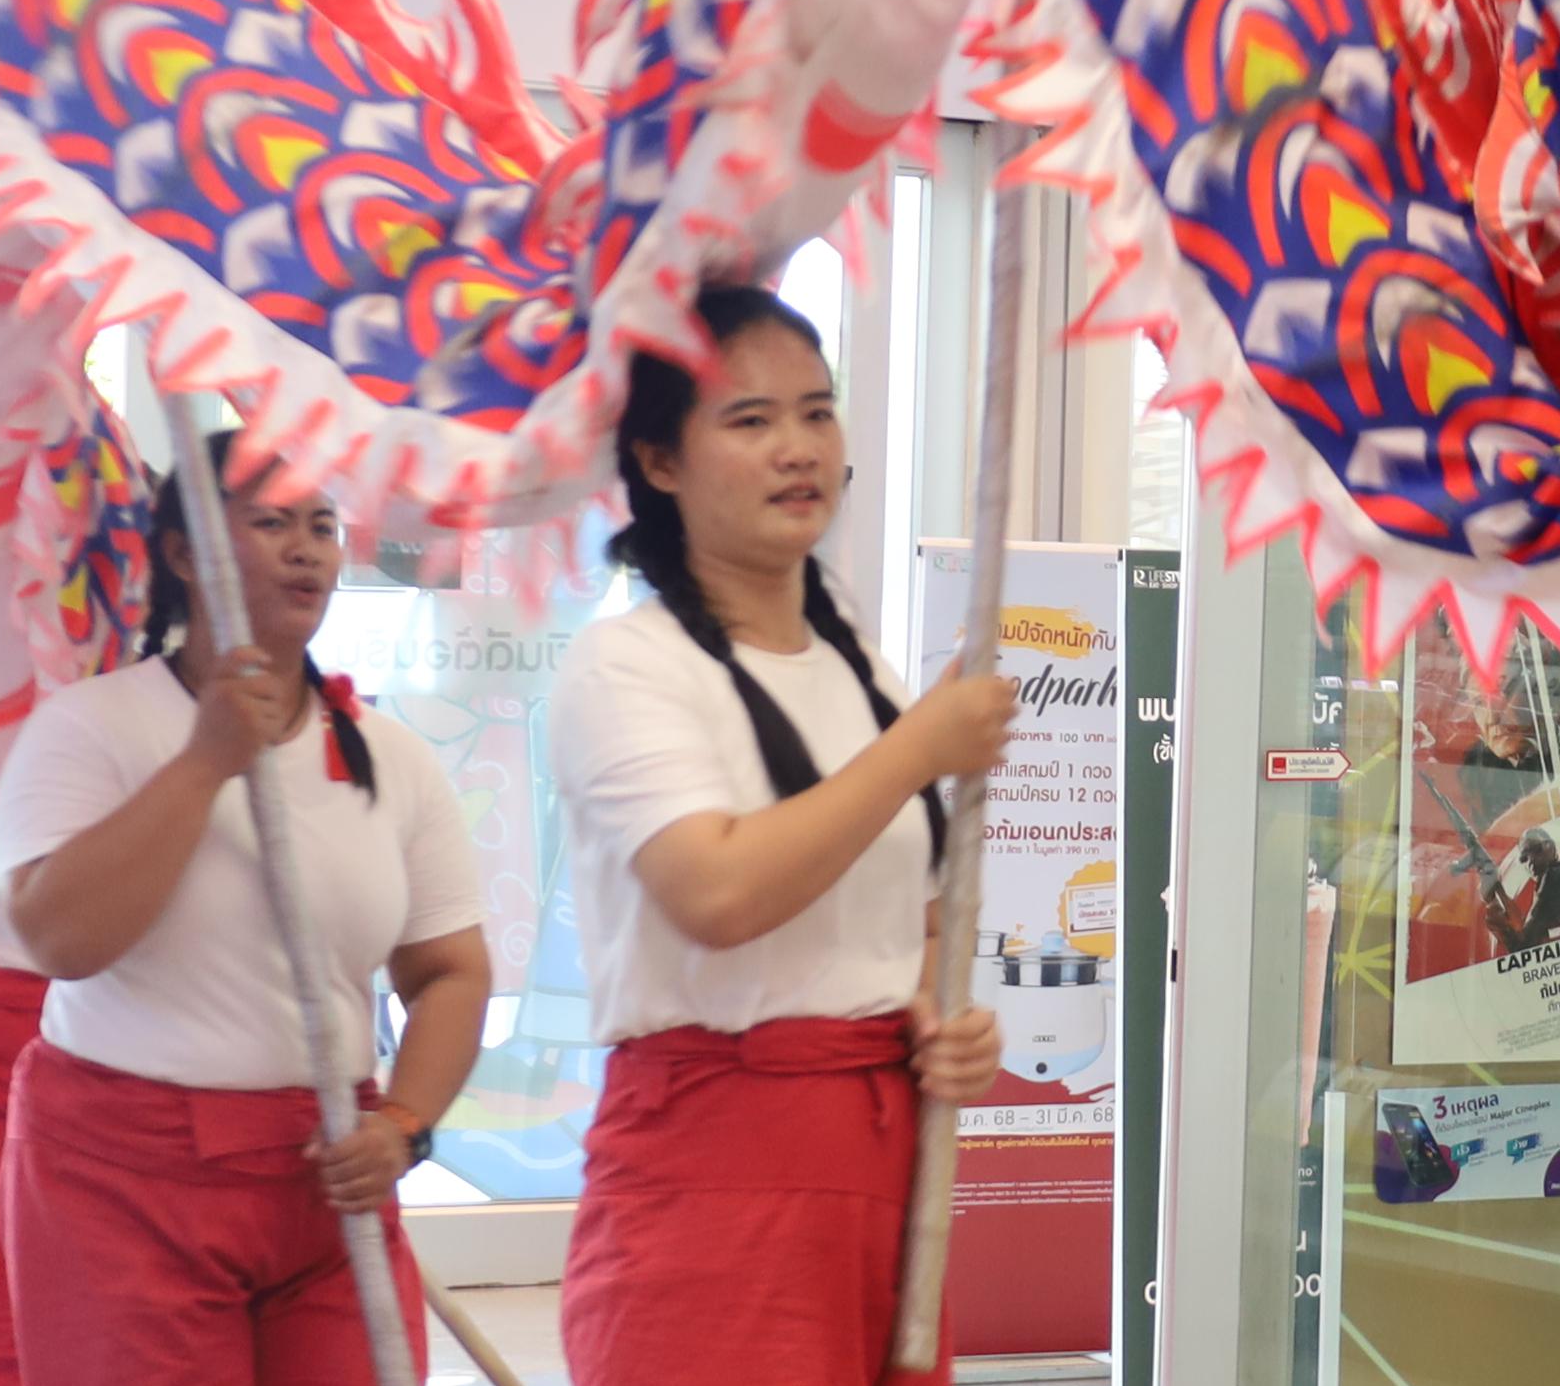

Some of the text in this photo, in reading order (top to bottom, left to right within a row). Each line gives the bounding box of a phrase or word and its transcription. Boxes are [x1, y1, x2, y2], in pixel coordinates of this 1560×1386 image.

[1059, 731, 1079, 744] 100
[1083, 732, 1105, 743] บาท
[1067, 763, 1074, 779] 1
[1083, 764, 1112, 780] ดวง
[1067, 787, 1087, 803] 12
[1432, 1092, 1500, 1120] 3 เหตุผล
[993, 1109, 1016, 1126] 68
[1092, 1106, 1115, 1123] 68
